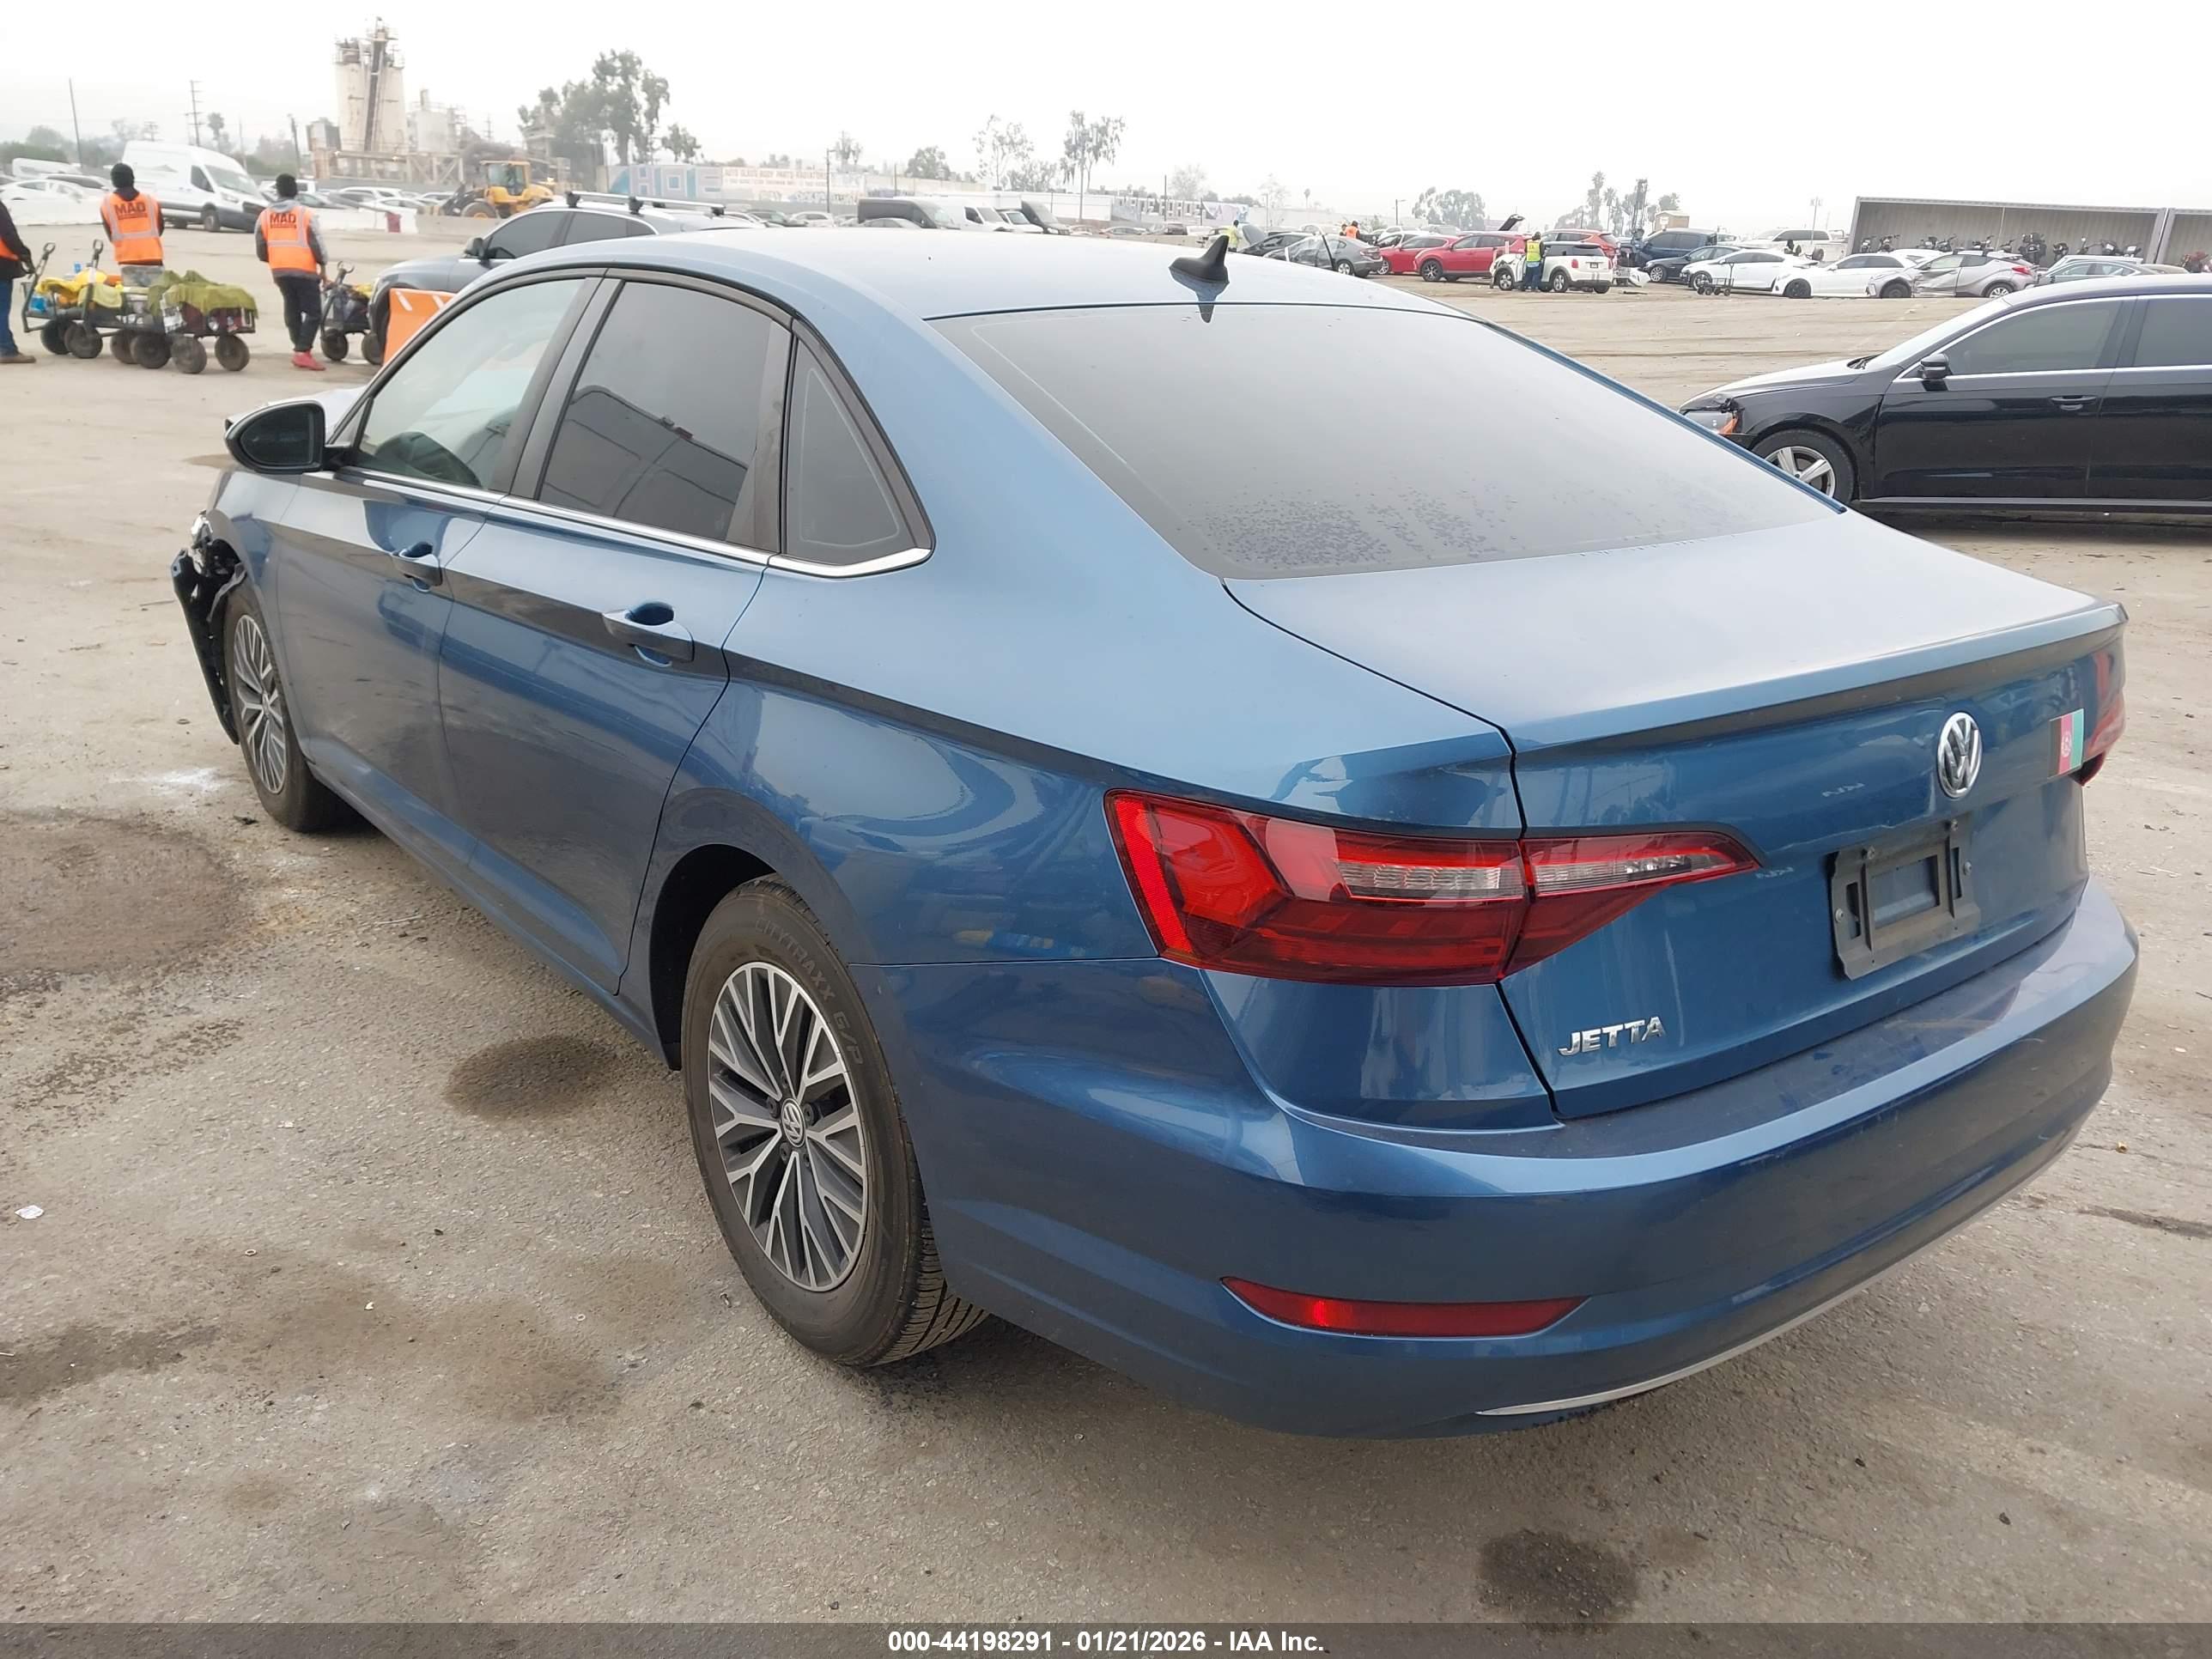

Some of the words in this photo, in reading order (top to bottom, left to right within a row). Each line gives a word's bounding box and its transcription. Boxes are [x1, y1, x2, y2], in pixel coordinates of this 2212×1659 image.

[114, 202, 146, 215] MAD
[270, 213, 296, 223] MAD
[755, 919, 836, 1001] CITYTRAXX
[833, 1012, 863, 1064] G/P
[1558, 1017, 1664, 1055] JETTA
